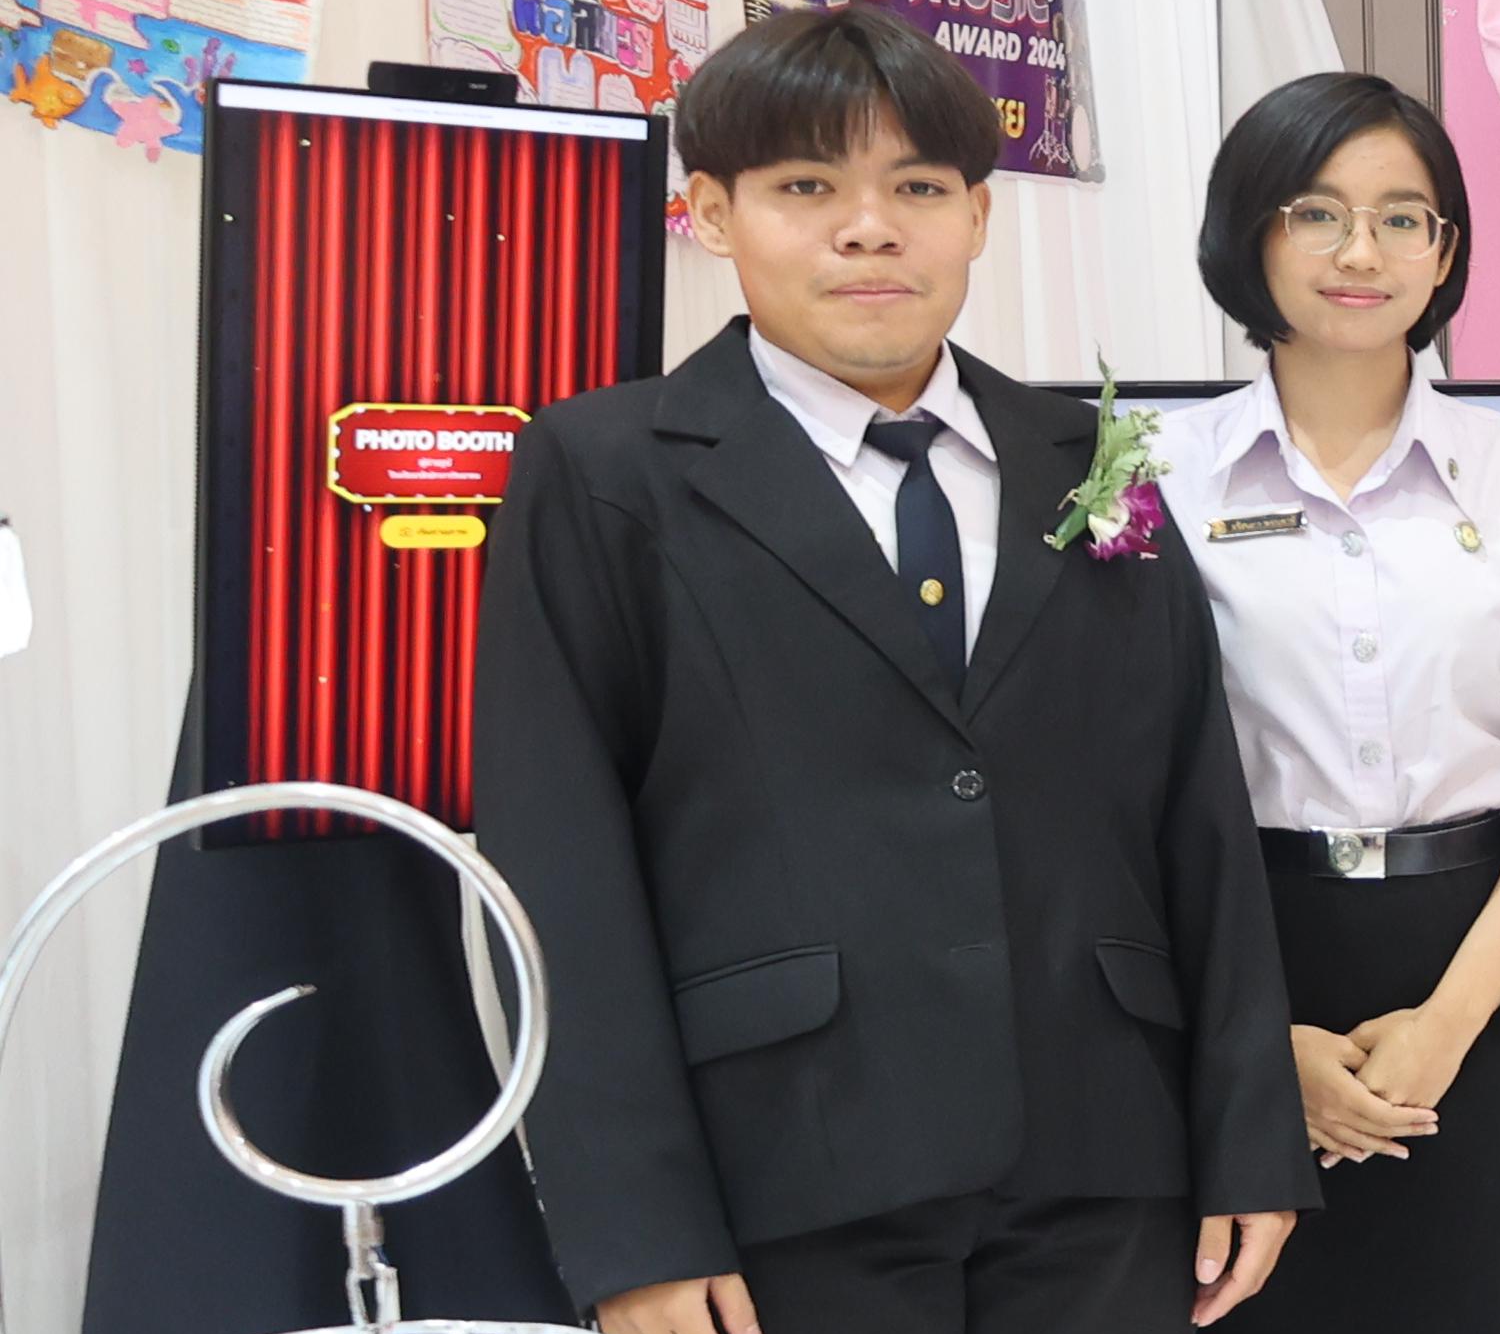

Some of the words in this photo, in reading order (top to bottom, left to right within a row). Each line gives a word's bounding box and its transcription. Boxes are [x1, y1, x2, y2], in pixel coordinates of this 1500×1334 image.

[934, 21, 1022, 62] AWARD
[1027, 38, 1066, 70] 2024
[355, 429, 434, 451] PHOTO
[437, 431, 514, 452] BOOTH
